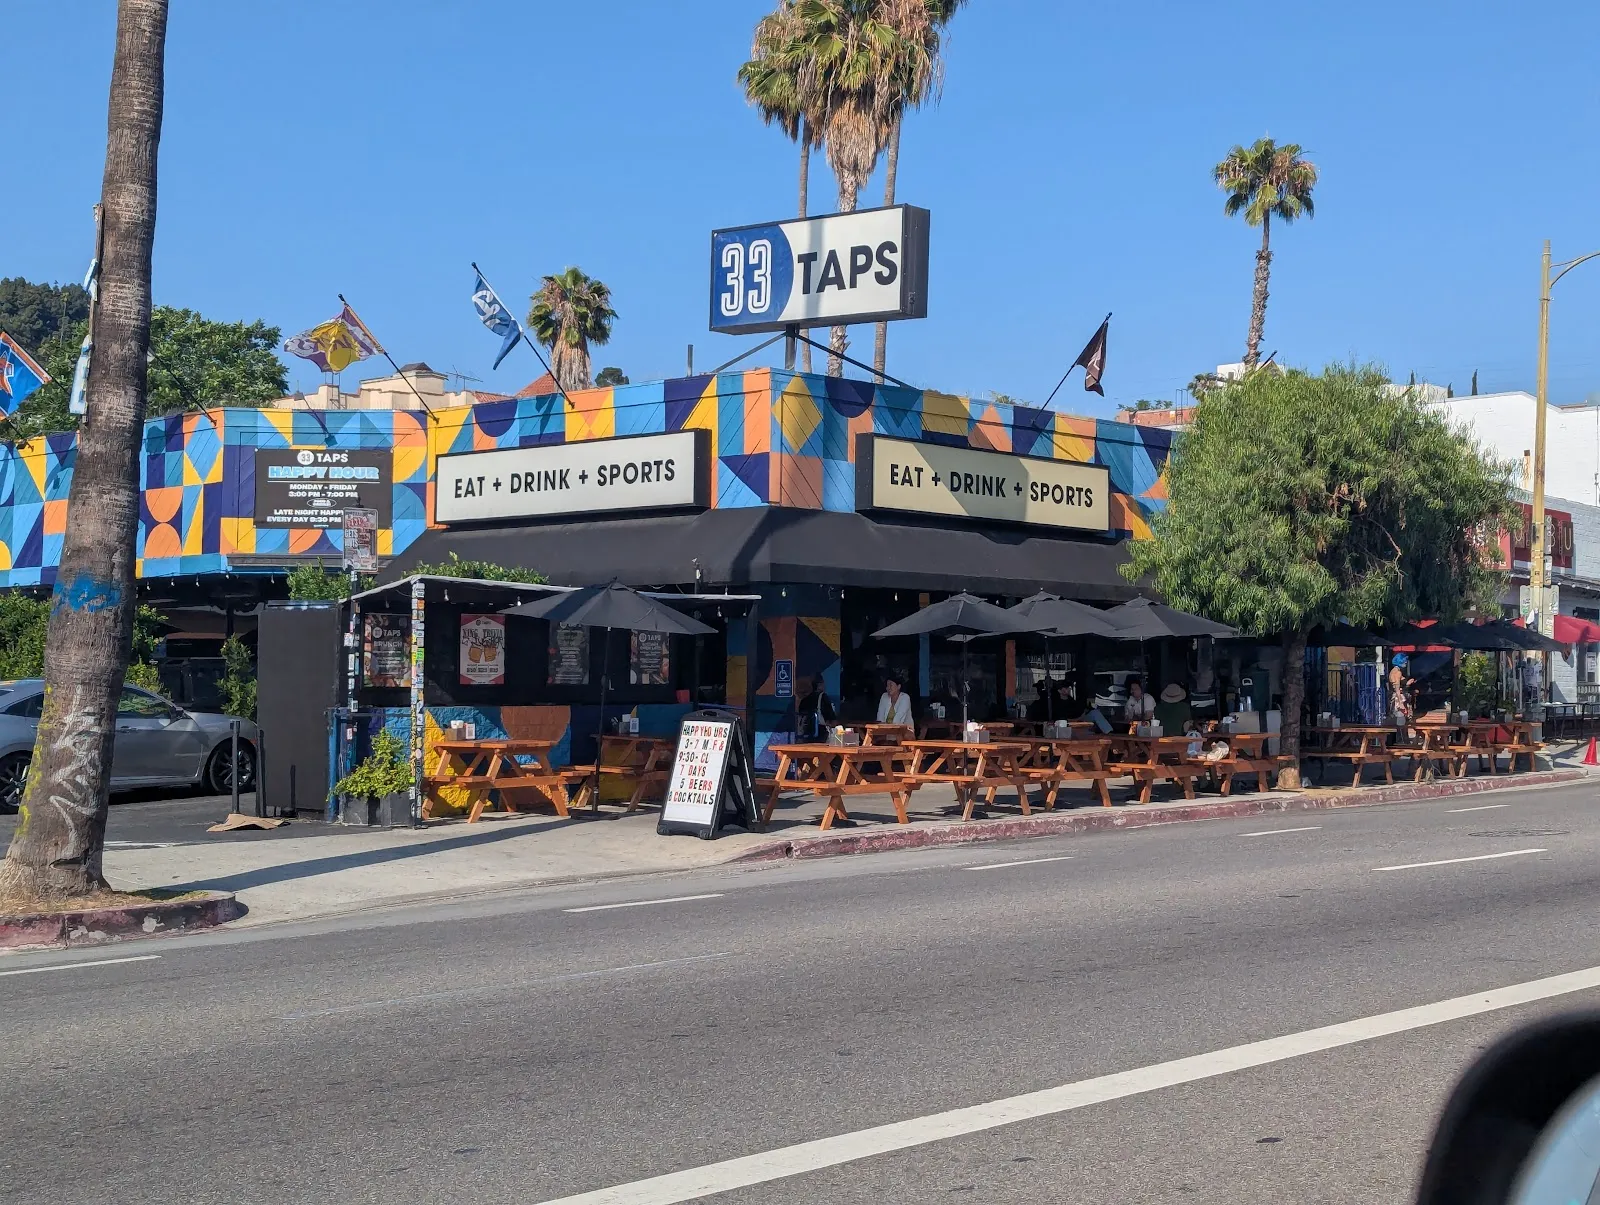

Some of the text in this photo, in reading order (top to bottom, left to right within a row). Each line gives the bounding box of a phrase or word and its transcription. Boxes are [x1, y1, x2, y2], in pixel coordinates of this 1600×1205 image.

[721, 238, 898, 317] 33 TAPS
[316, 453, 349, 463] TAPS
[268, 465, 380, 480] HAPPY HOUR
[454, 458, 676, 499] EAT + DRINK + SPORTS
[890, 463, 1093, 508] EAT + DRINK + SPORTS
[345, 491, 359, 499] PM
[383, 629, 401, 637] TAPS
[680, 764, 707, 777] 7 DAYS
[680, 778, 713, 791] 5 BEERS
[673, 791, 715, 805] COCKTAILS
